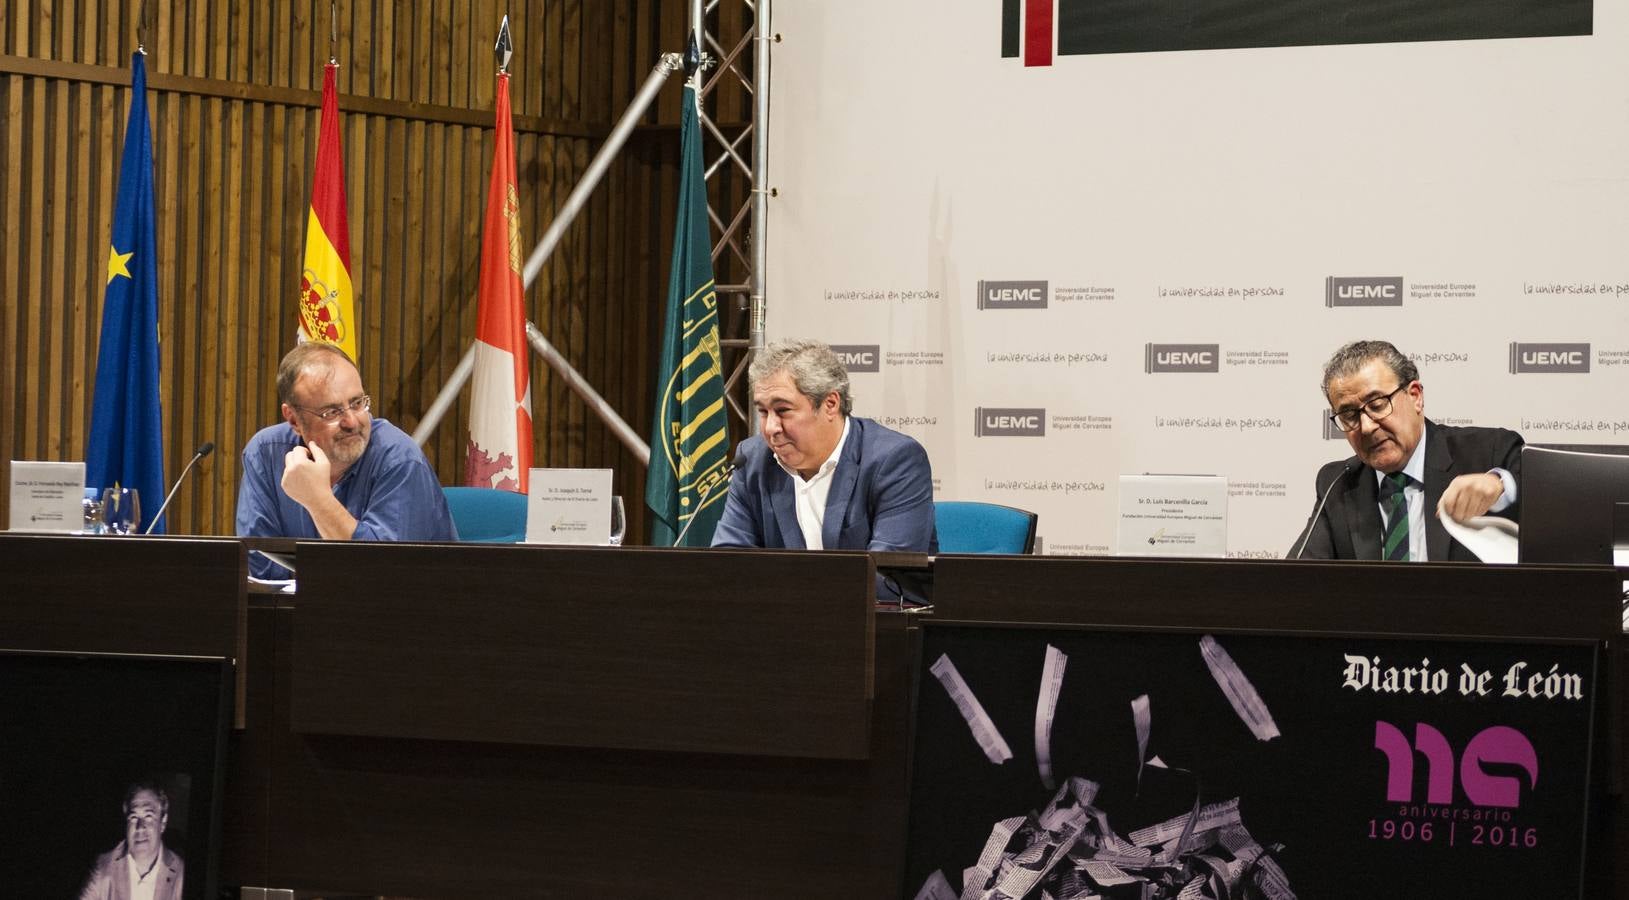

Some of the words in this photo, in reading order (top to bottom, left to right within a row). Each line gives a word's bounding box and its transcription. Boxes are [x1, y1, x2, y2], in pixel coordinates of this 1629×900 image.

[1055, 286, 1089, 294] Universidad
[1091, 286, 1115, 295] Europea
[1158, 286, 1167, 298] la
[1169, 287, 1225, 298] universidad
[1228, 288, 1240, 297] en
[1243, 287, 1284, 301] persona
[1338, 285, 1396, 298] UEMC
[1449, 283, 1476, 291] Europea
[1524, 282, 1533, 296] la
[1536, 284, 1597, 296] universidad
[1600, 284, 1613, 295] en
[824, 288, 832, 302] la
[834, 289, 885, 300] universidad
[888, 290, 899, 300] en
[901, 290, 940, 303] persona
[988, 288, 1042, 301] UEMC
[1055, 294, 1075, 303] Miguel
[1411, 291, 1432, 299] Miguel
[1443, 290, 1476, 298] Cervantes
[836, 353, 873, 365] EMC
[987, 352, 995, 363] la
[998, 352, 1051, 363] universidad
[1054, 353, 1066, 362] en
[1068, 353, 1108, 367] persona
[1157, 352, 1212, 365] UEMC
[1263, 351, 1289, 359] Europea
[1424, 352, 1469, 366] persona
[1522, 351, 1583, 365] UEMC
[1226, 359, 1247, 367] Miguel
[899, 416, 937, 429] persona
[986, 416, 1039, 429] UEMC
[1088, 415, 1112, 423] Europea
[1156, 416, 1164, 428] la
[1166, 417, 1222, 428] universidad
[1225, 418, 1238, 428] en
[1240, 418, 1282, 432] persona
[1520, 417, 1530, 431] la
[1533, 418, 1594, 431] universidad
[1597, 420, 1610, 431] en
[1052, 423, 1072, 431] Miguel
[985, 479, 993, 490] la
[995, 480, 1048, 491] universidad
[1051, 481, 1064, 491] en
[1066, 481, 1105, 496] persona
[1342, 653, 1449, 695] Diario
[1458, 662, 1494, 696] de
[1501, 661, 1584, 700] León
[1399, 803, 1512, 822] aniversario
[1368, 819, 1434, 840] 1906
[1471, 825, 1537, 848] 2016
